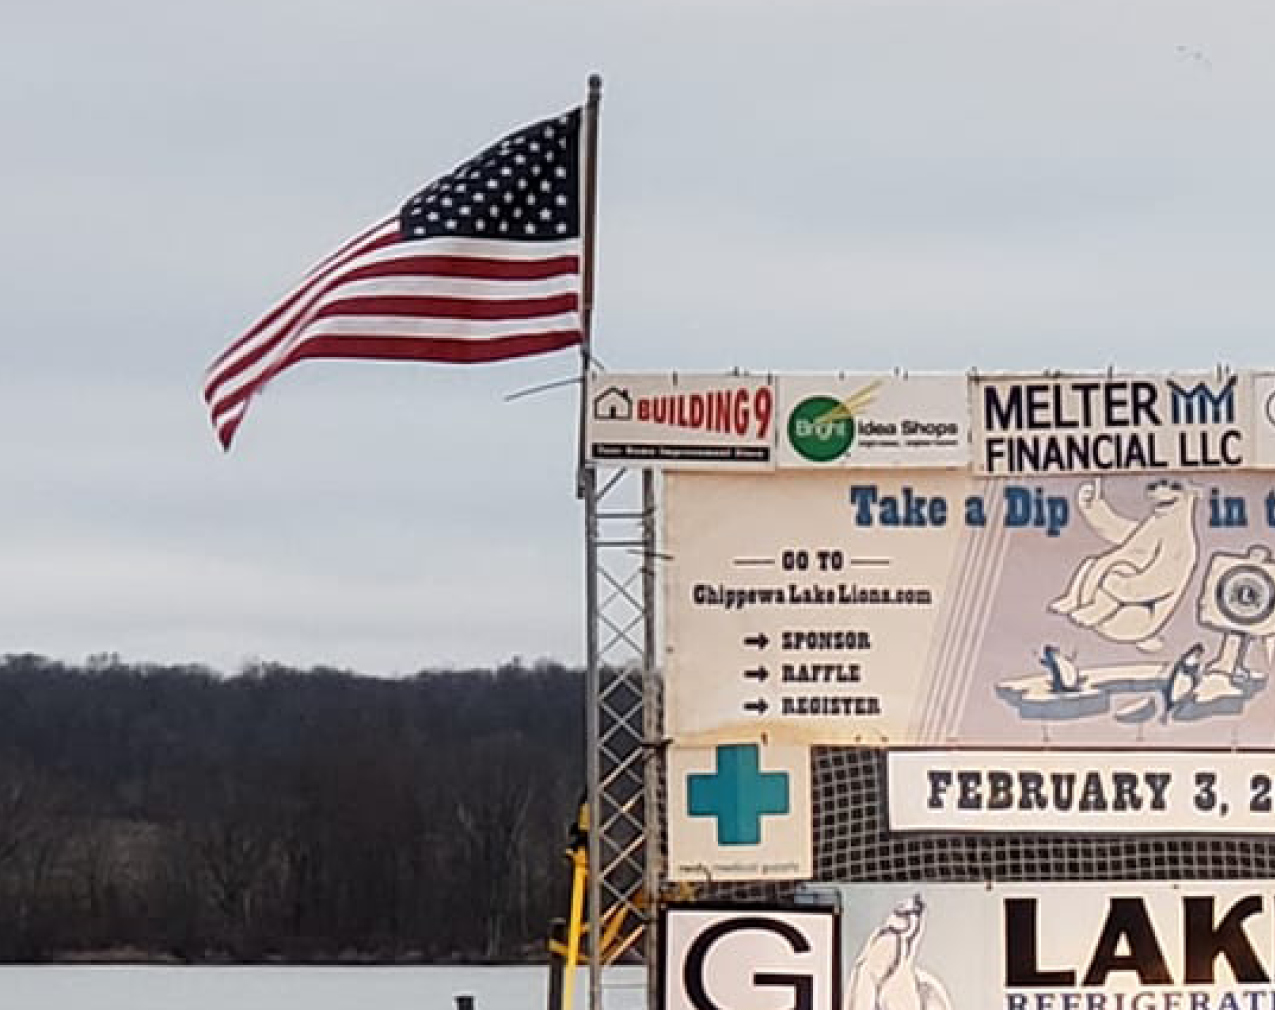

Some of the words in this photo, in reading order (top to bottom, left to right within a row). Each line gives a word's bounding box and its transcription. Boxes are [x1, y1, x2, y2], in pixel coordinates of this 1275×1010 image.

[983, 381, 1163, 432] MELTER
[857, 419, 897, 437] Idea
[900, 418, 960, 439] Shops
[985, 432, 1170, 474] FINANCIAL
[1178, 429, 1244, 467] LLC
[849, 485, 949, 528] Take
[964, 495, 988, 529] a
[1002, 486, 1070, 537] Dip
[1208, 487, 1249, 528] in
[781, 550, 810, 573] GO
[817, 550, 844, 572] TO
[781, 631, 871, 650] SPONSOR
[781, 664, 861, 683] RAFFLE
[781, 696, 881, 716] REGISTER
[927, 769, 1173, 812] FEBRUARY
[1193, 771, 1230, 817] 3,
